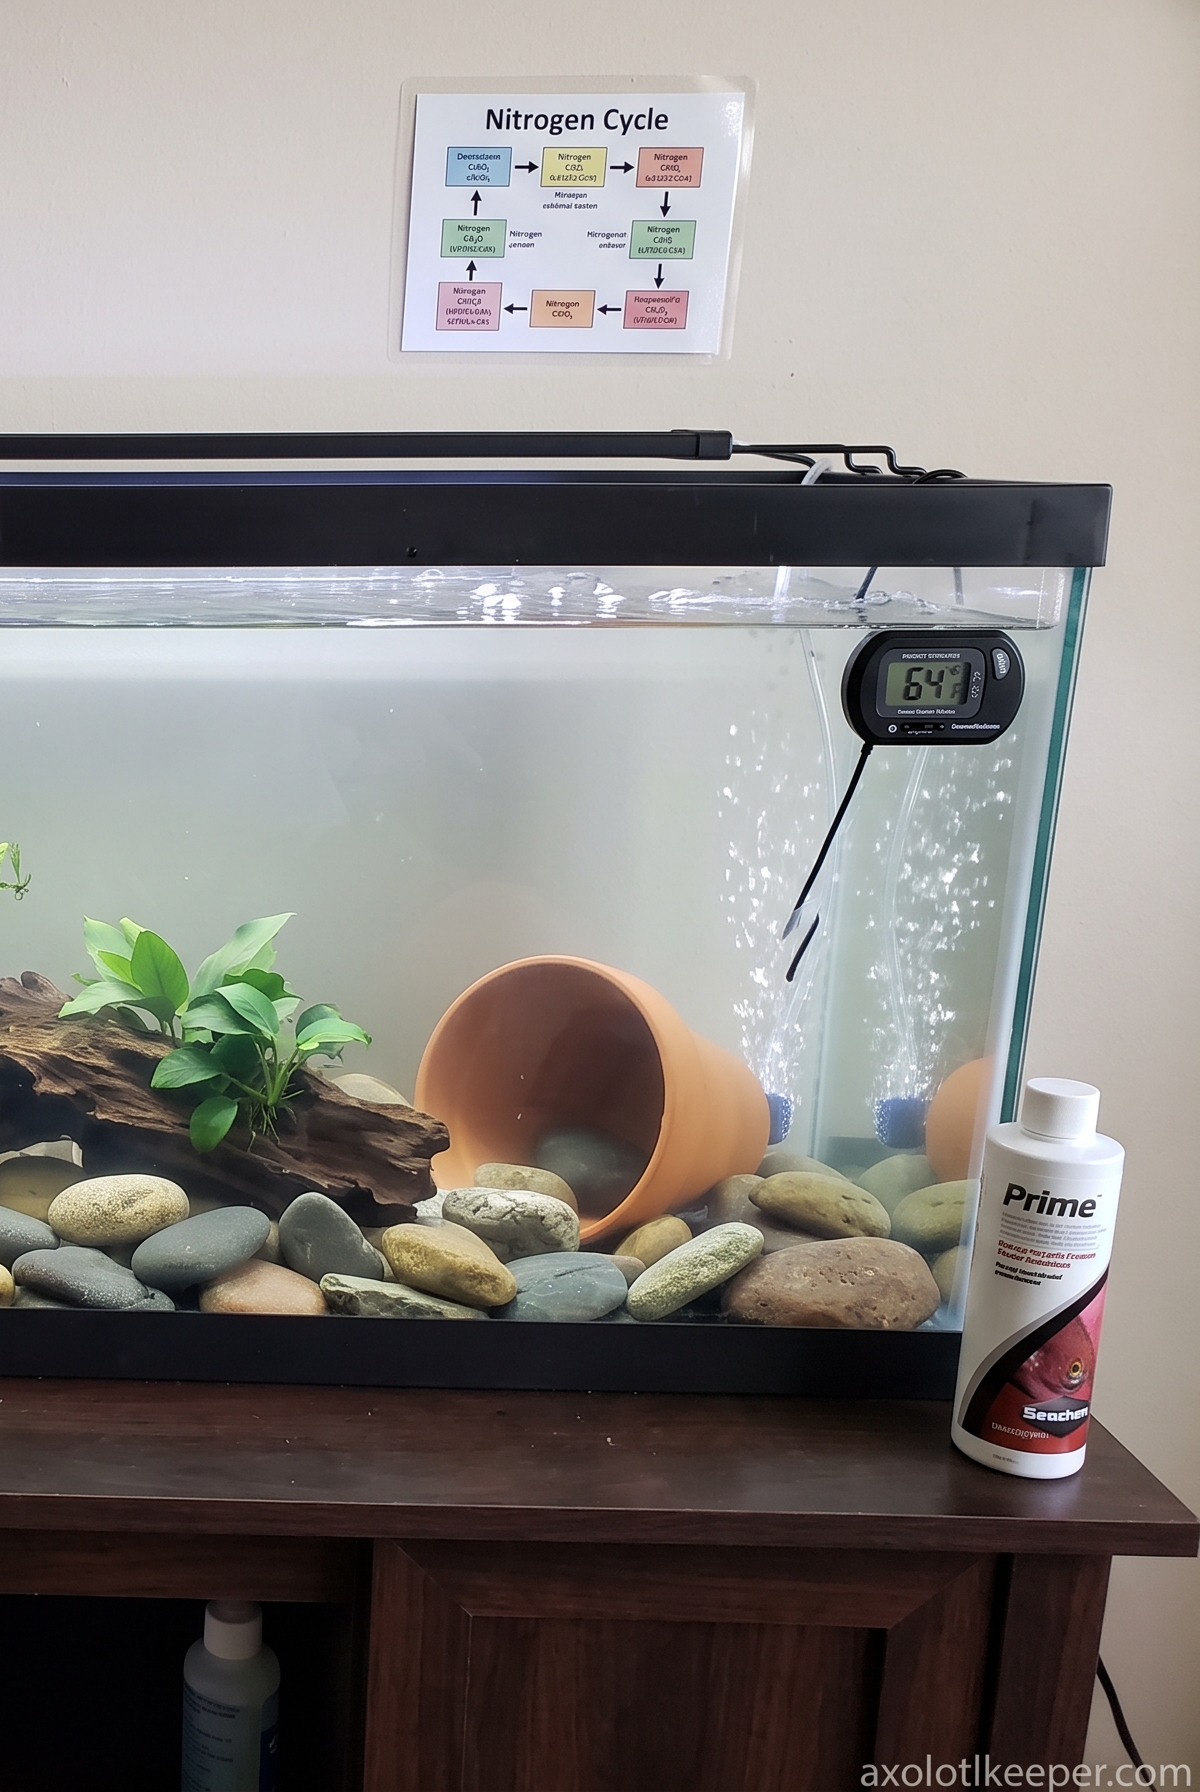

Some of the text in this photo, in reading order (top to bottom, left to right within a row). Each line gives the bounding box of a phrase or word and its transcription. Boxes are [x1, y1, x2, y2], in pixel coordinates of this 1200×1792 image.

[485, 107, 669, 135] Nitrogen Cycle
[558, 153, 592, 163] Nitrogen
[457, 225, 491, 234] Nitrogen
[509, 230, 543, 239] Nitrogen
[647, 226, 681, 235] Nitrogen
[903, 666, 945, 701] 64
[1002, 1182, 1097, 1218] Prime
